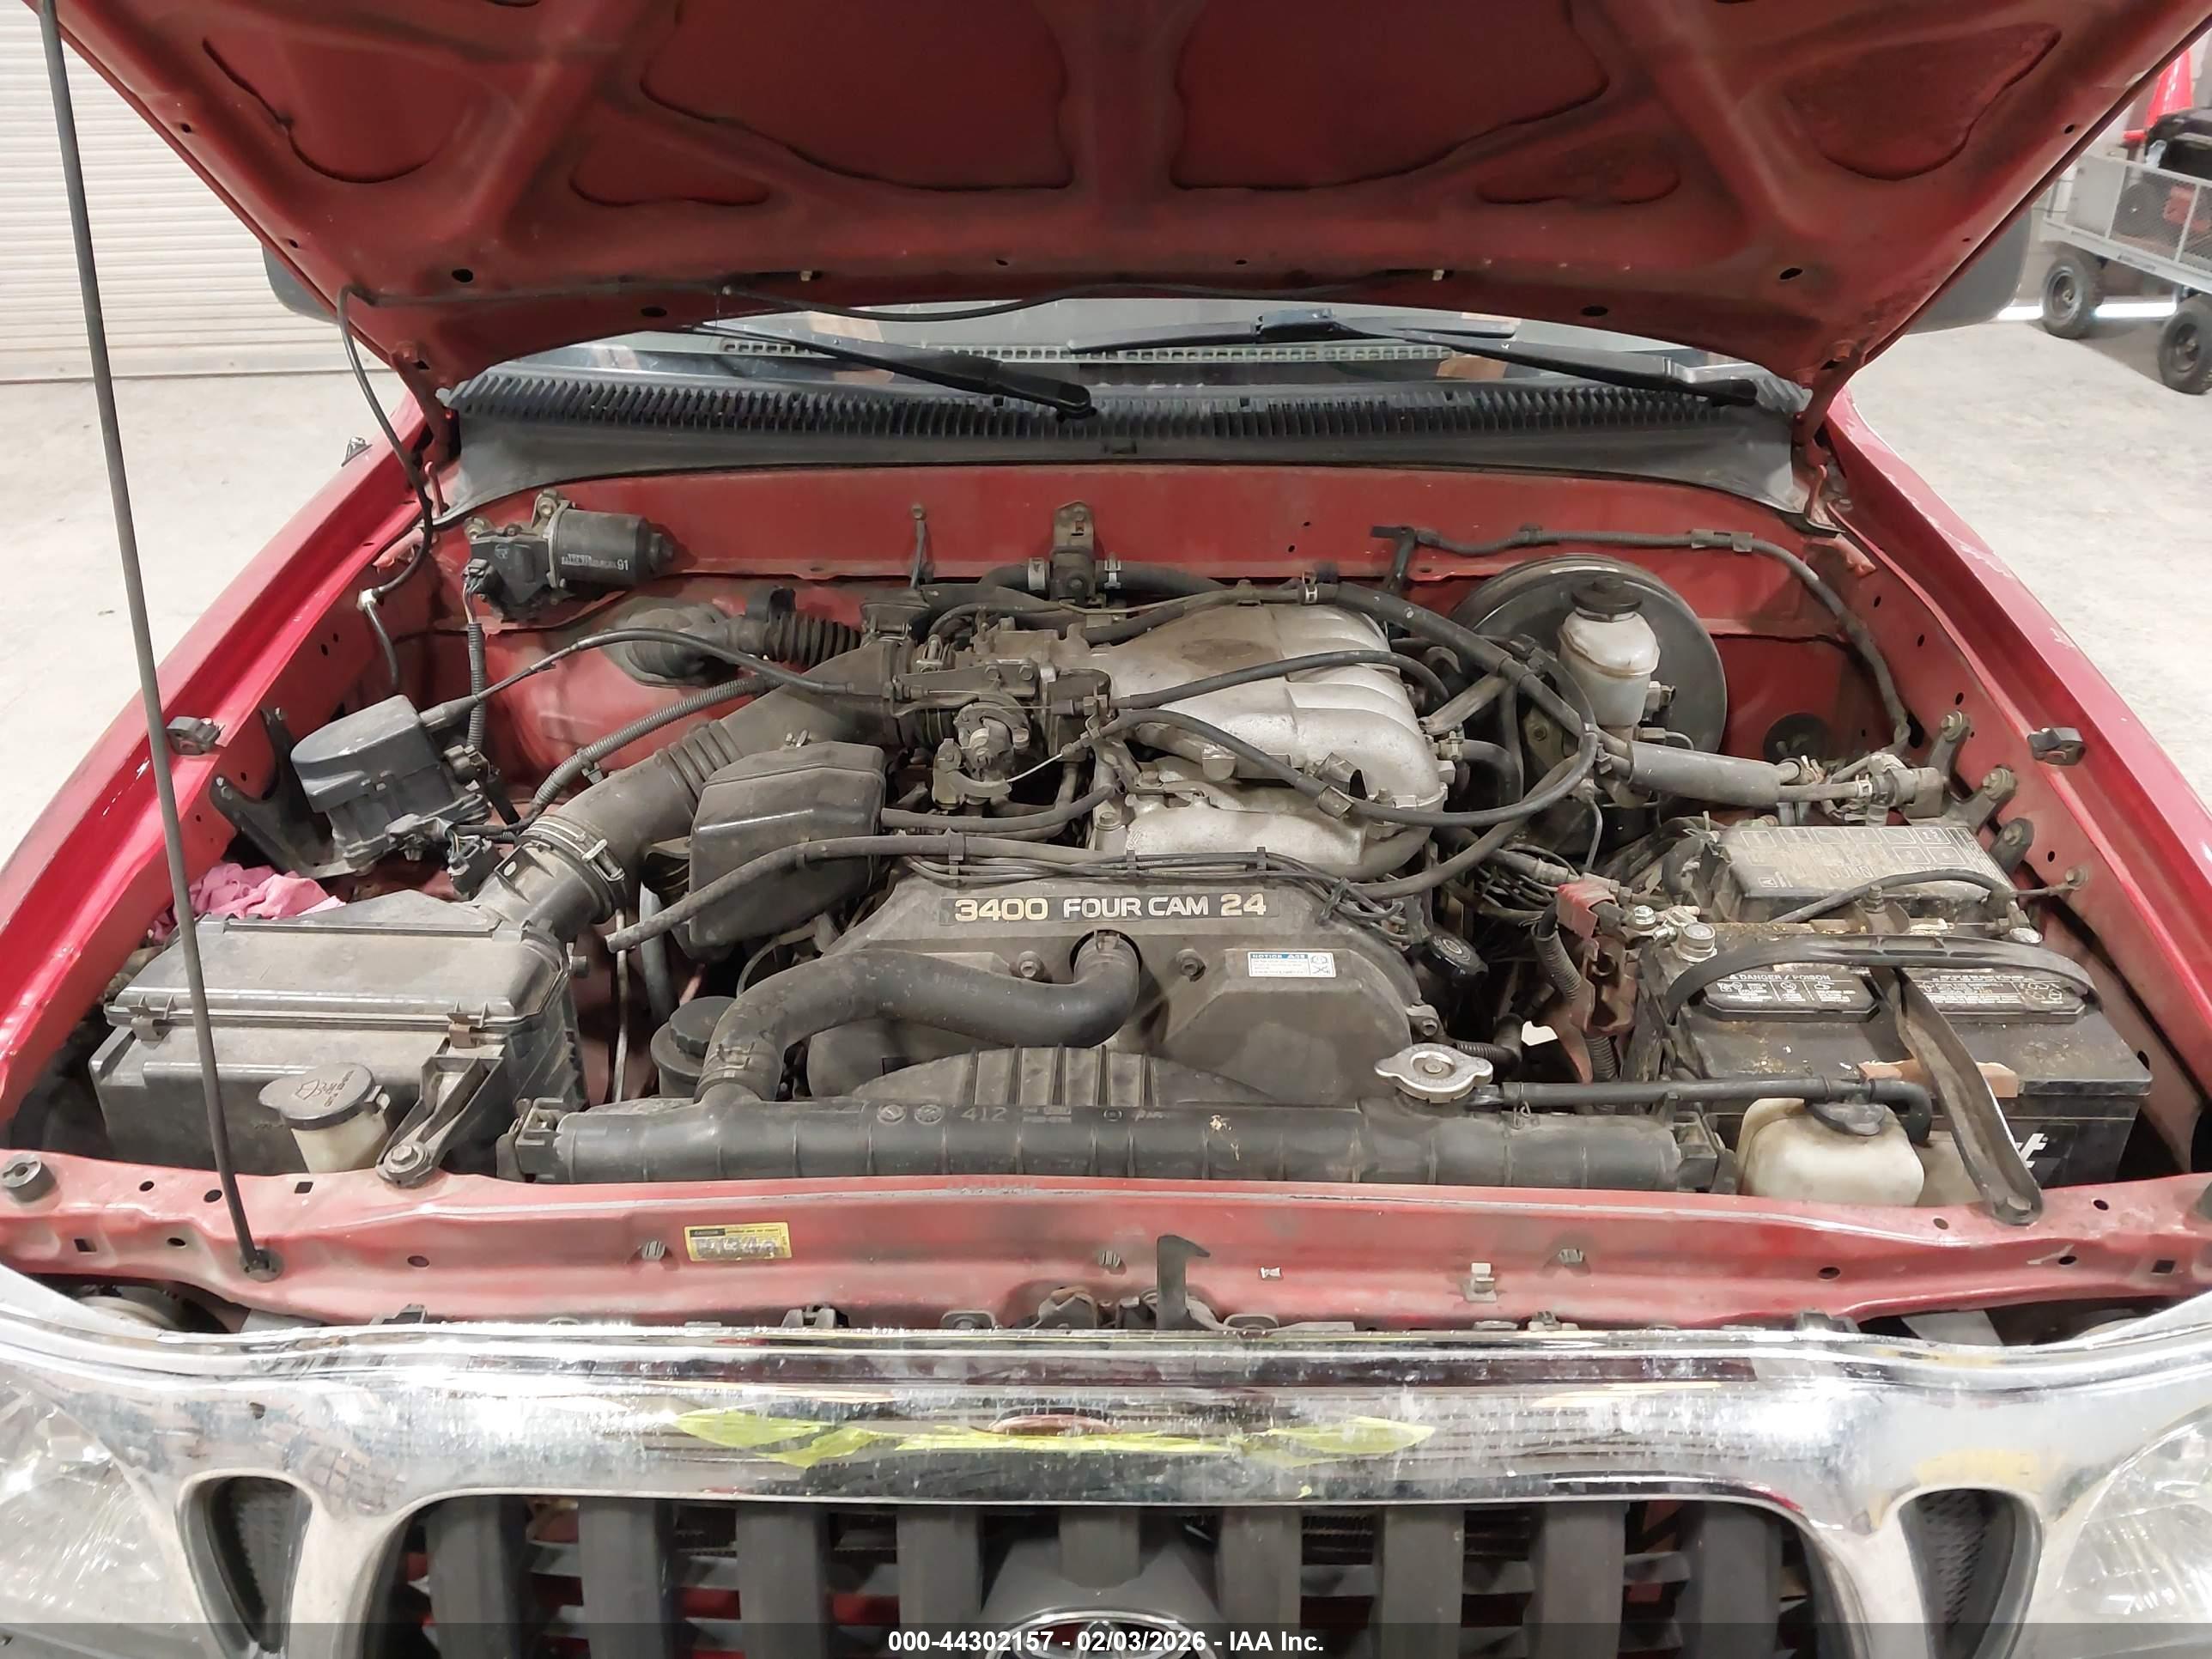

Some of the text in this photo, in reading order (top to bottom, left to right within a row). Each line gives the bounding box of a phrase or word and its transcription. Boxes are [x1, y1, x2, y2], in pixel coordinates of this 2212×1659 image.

[617, 558, 629, 571] 91
[954, 893, 1267, 921] 3400 FOUR CAM 24
[961, 1106, 1007, 1121] 412
